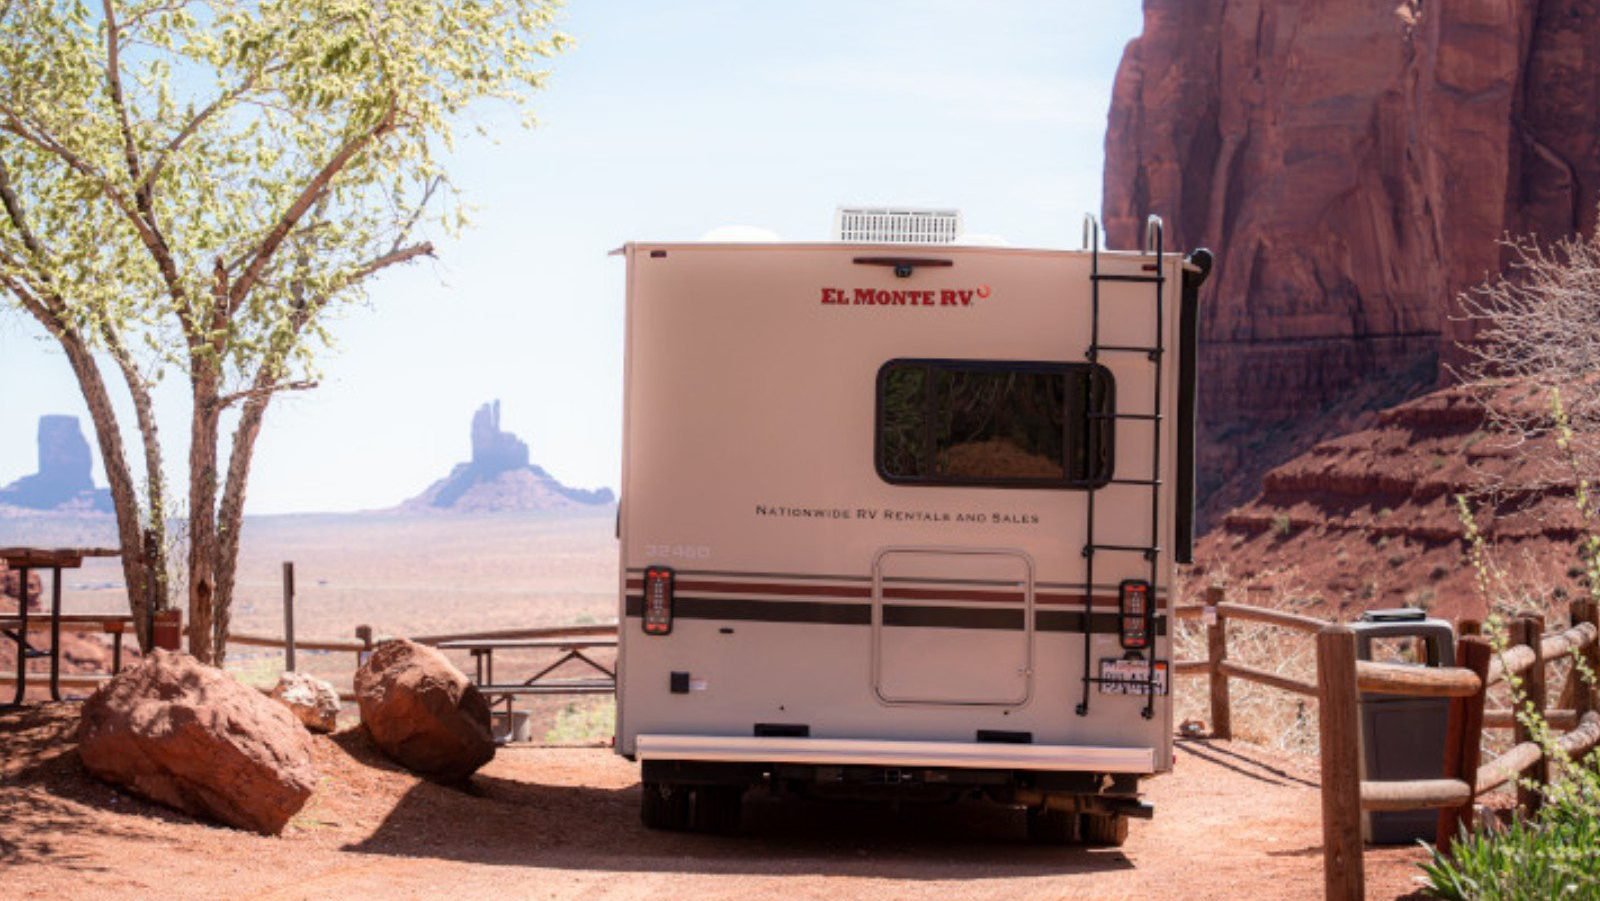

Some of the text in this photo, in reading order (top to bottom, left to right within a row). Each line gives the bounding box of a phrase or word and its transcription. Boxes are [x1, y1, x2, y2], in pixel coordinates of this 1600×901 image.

[821, 288, 973, 306] EL MONTE RV
[756, 505, 851, 520] NATIONWIDE
[856, 508, 877, 520] RV
[883, 509, 950, 522] RENTALS
[992, 512, 1039, 524] SALES
